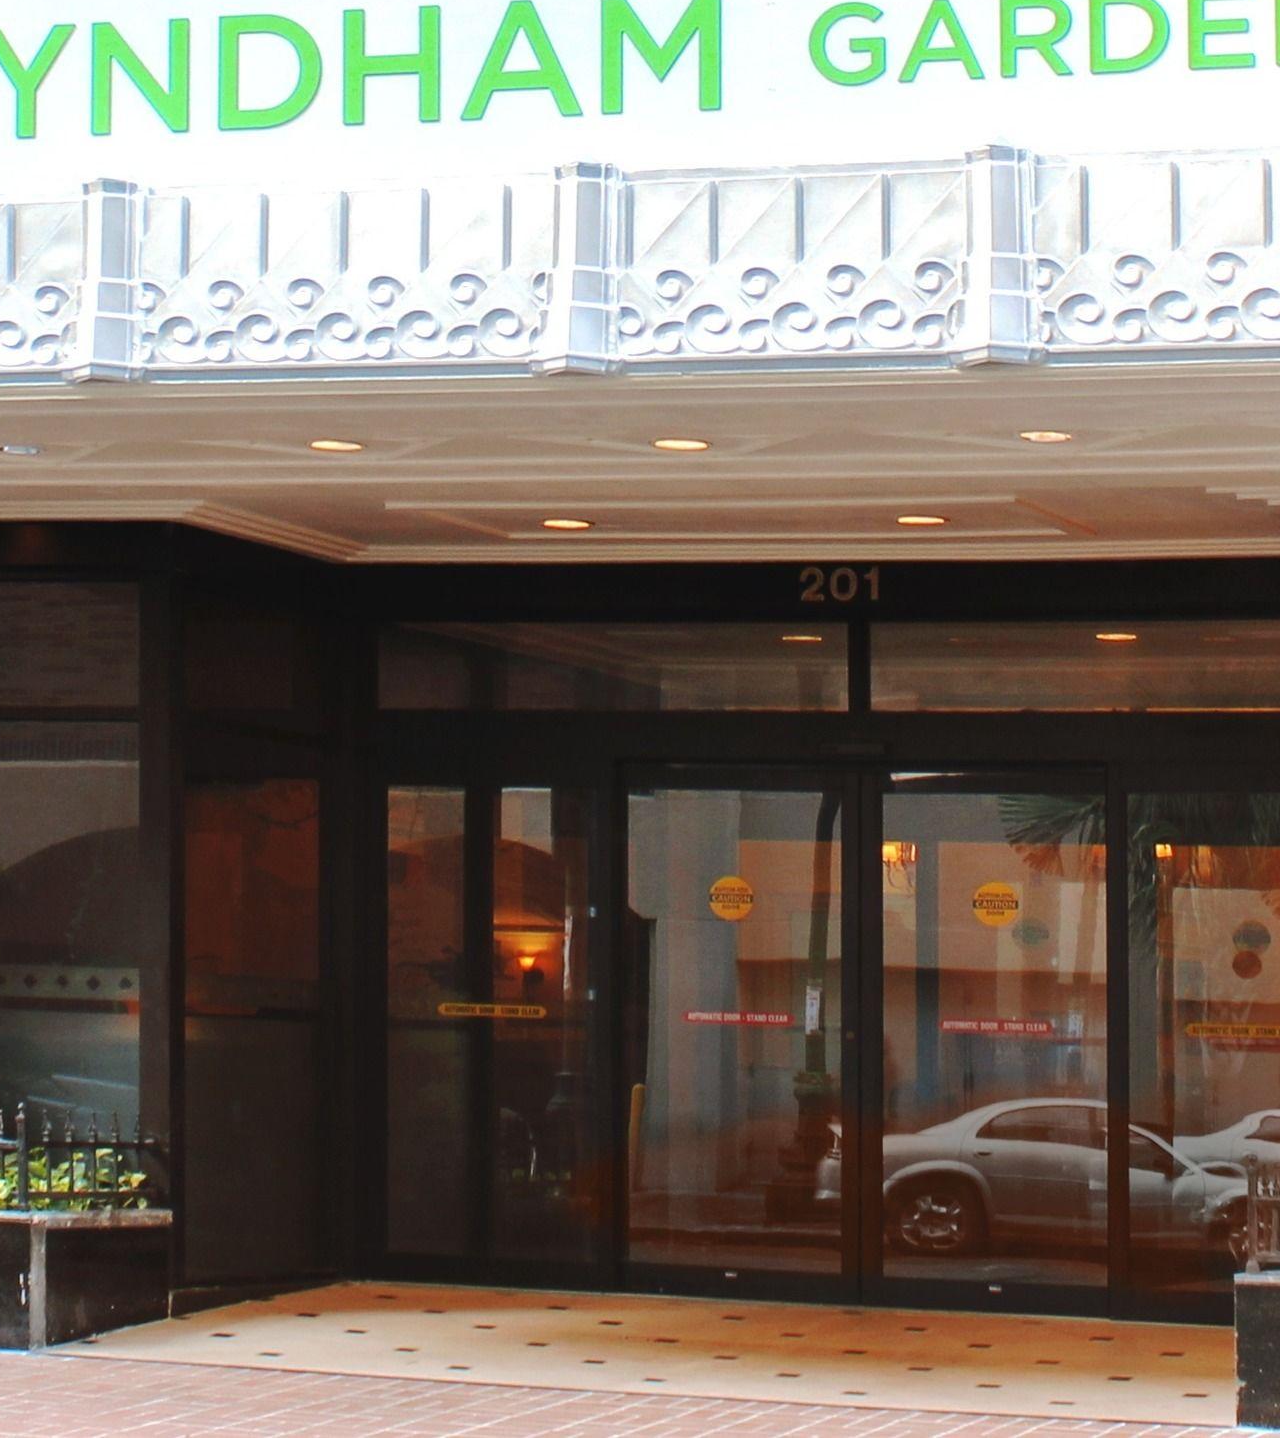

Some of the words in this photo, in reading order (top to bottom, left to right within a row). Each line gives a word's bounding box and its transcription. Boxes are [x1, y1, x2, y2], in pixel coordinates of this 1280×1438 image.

[800, 566, 879, 601] 201
[712, 894, 751, 902] CAUTION
[975, 900, 1016, 909] CAUTION
[687, 1012, 723, 1021] AUTOMATIC
[724, 1013, 740, 1022] DOOR
[746, 1014, 767, 1023] STAND
[768, 1015, 788, 1023] CLEAR
[943, 1021, 979, 1030] AUTOMATIC
[980, 1022, 999, 1031] DOOR
[1003, 1023, 1024, 1032] STAND
[1025, 1023, 1048, 1032] CLEAR
